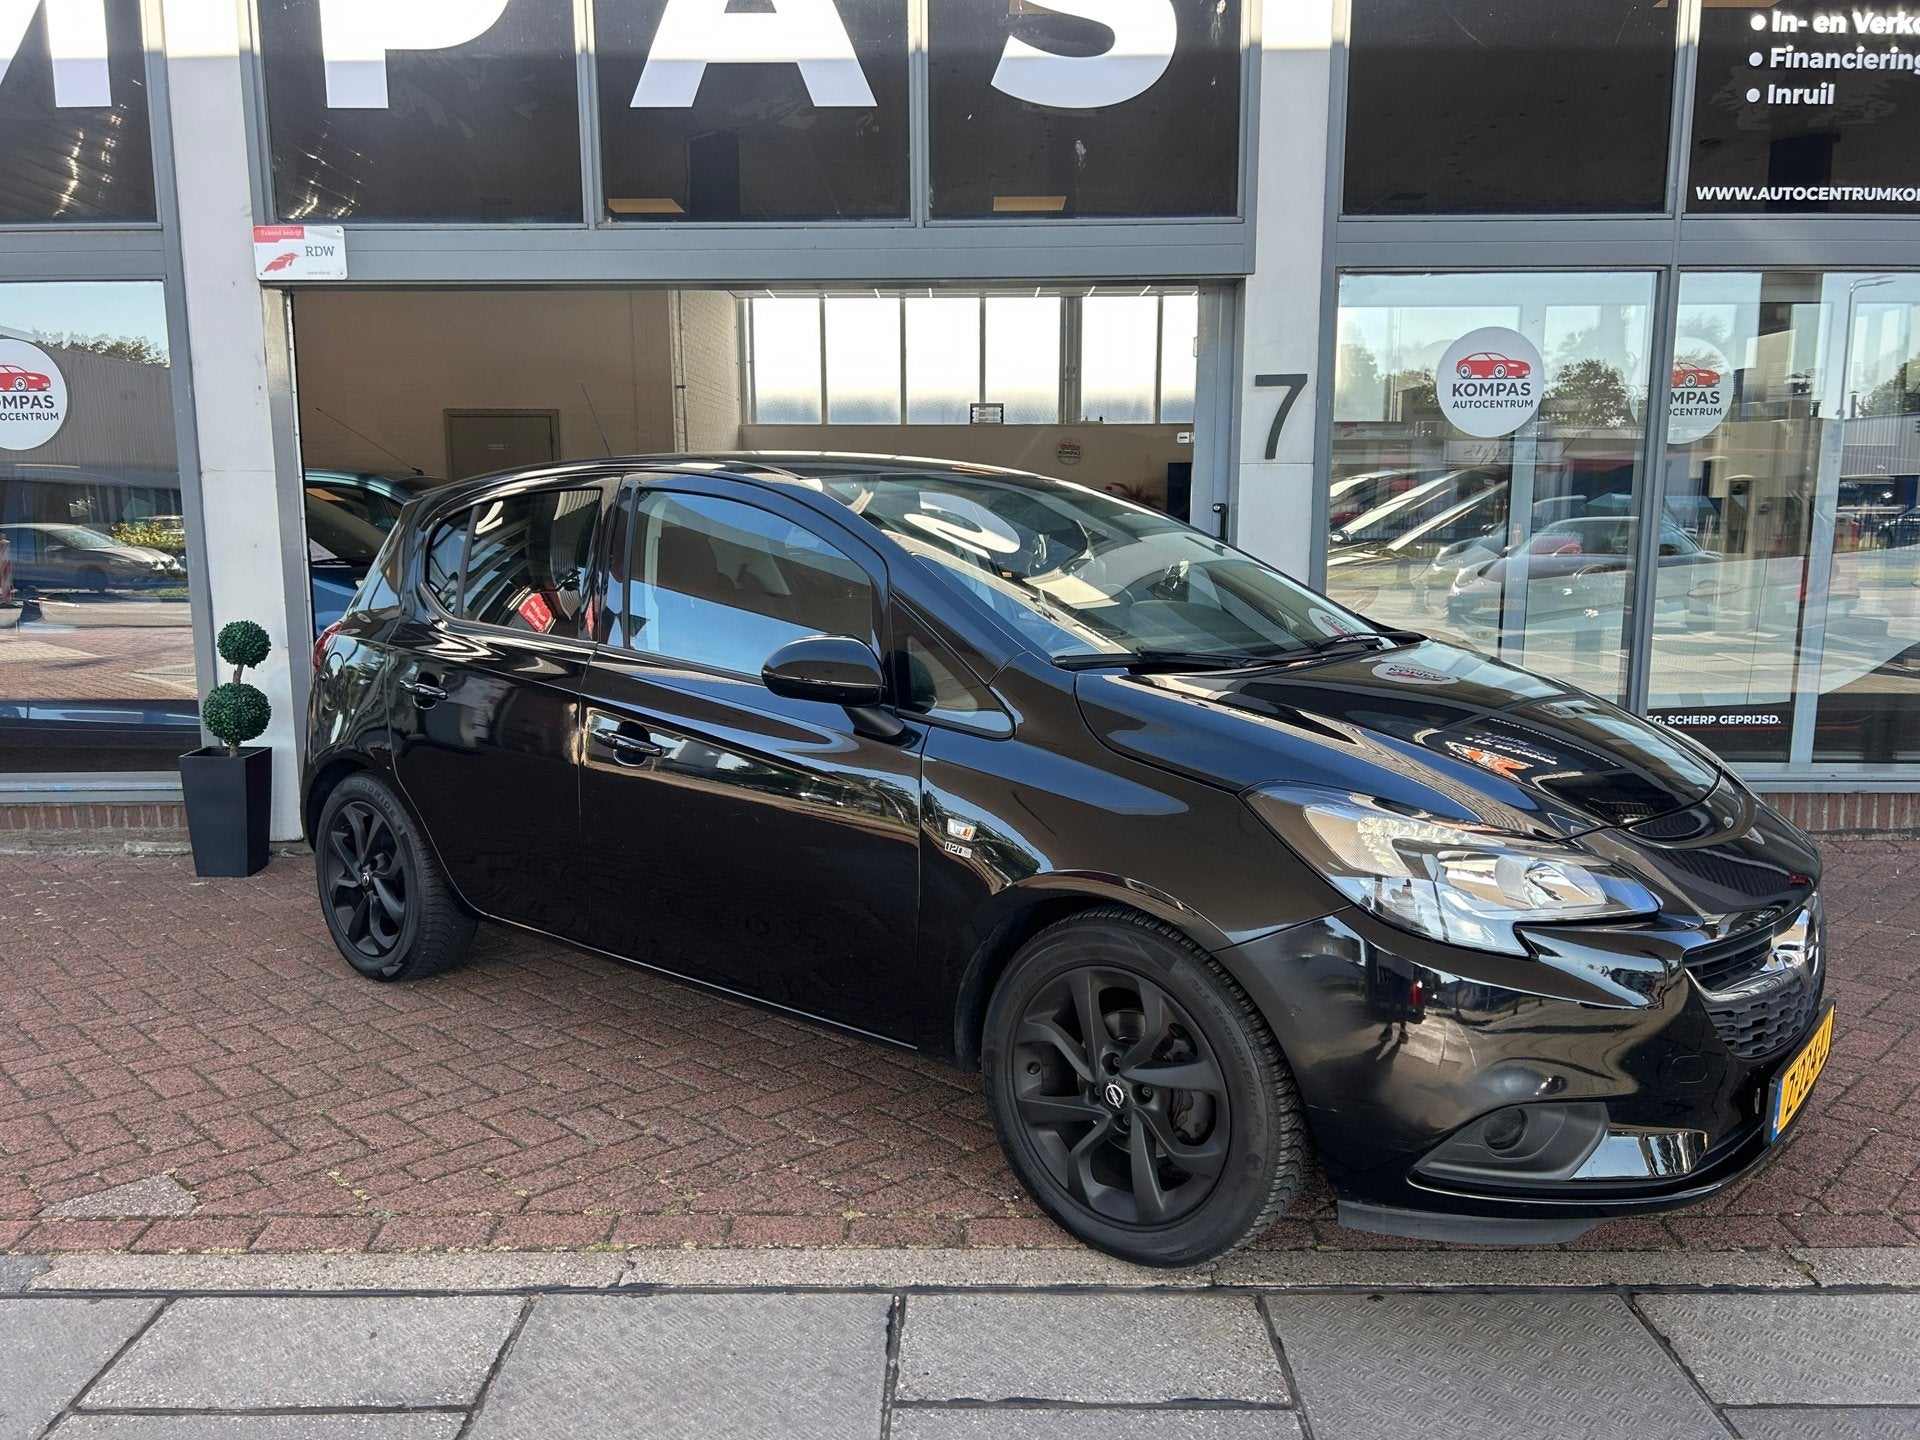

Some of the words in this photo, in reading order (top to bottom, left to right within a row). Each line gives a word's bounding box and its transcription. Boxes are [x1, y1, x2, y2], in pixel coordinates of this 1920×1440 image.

[1771, 10, 1808, 33] In-
[1813, 15, 1847, 33] en
[1767, 82, 1835, 105] Inruil
[1696, 186, 1920, 202] WWW.AUTOCENTRUMKO
[305, 246, 335, 257] RDW
[1452, 382, 1531, 397] KOMPAS
[0, 395, 55, 409] MPAS
[1452, 399, 1533, 409] AUTOCENTRUM
[1255, 374, 1308, 460] 7
[1667, 715, 1716, 725] SCHERP
[1719, 715, 1782, 725] GEPRIJSD.
